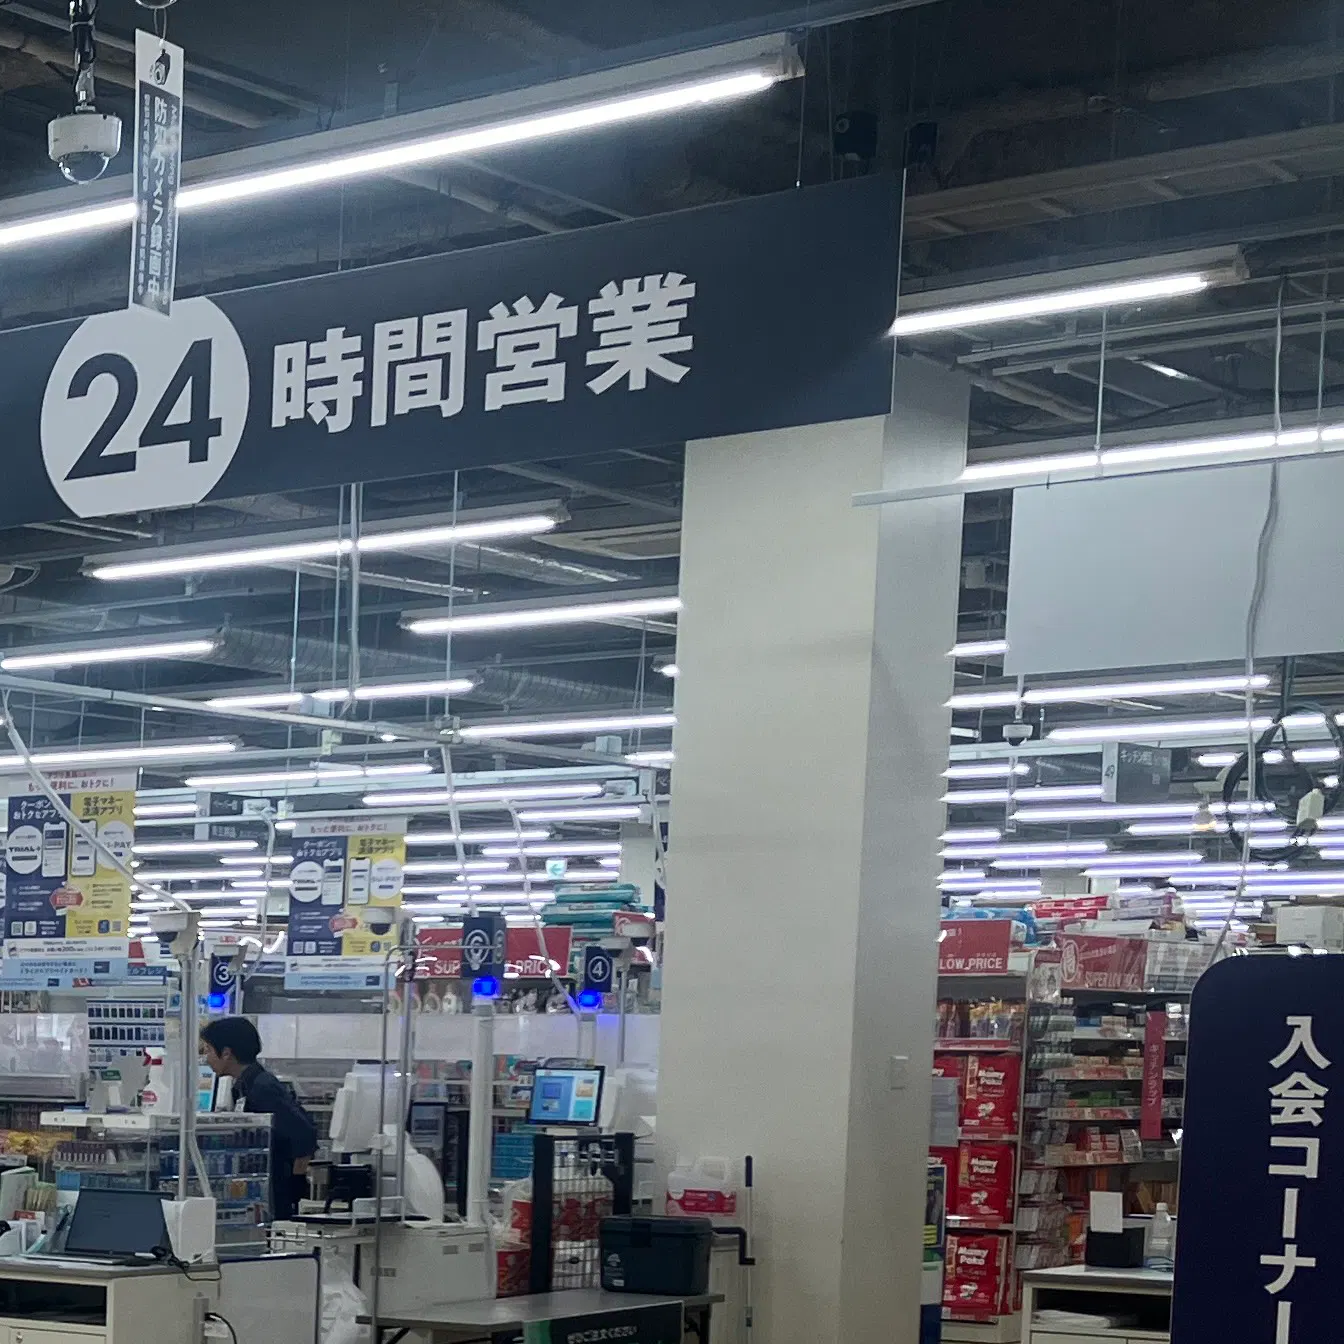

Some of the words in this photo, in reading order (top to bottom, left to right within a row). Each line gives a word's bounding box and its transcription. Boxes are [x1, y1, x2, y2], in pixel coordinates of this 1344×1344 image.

[63, 337, 222, 482] 24
[270, 271, 697, 433] 時間営業
[938, 957, 967, 970] LOW
[967, 957, 1004, 970] PRICE
